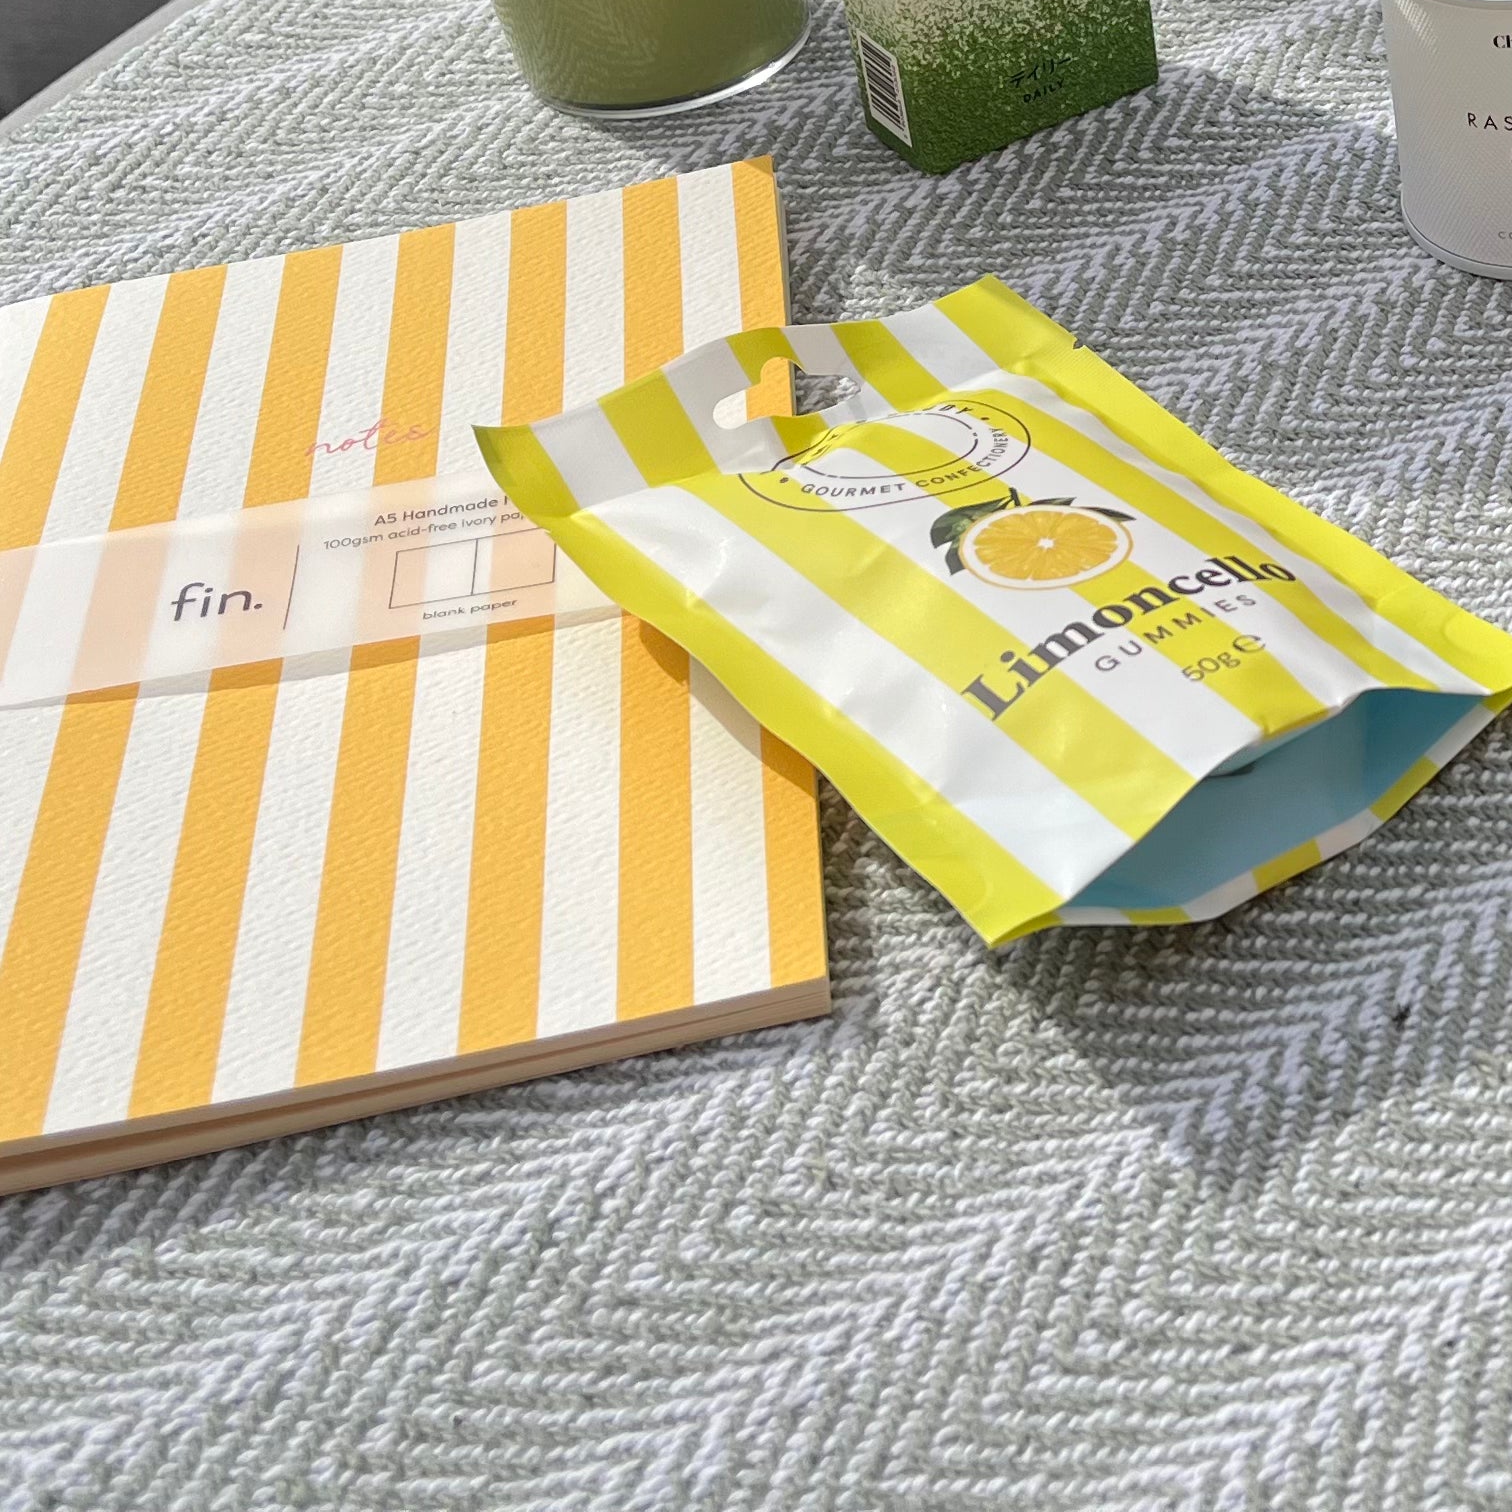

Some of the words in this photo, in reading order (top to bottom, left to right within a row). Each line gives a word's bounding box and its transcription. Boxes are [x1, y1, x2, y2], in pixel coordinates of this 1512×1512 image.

[1023, 77, 1065, 103] DAILY
[304, 416, 438, 457] notes
[801, 483, 906, 497] GOURMET
[915, 427, 1009, 487] CONFECTIONERY
[374, 513, 398, 527] A5
[402, 497, 499, 522] Handmade
[323, 533, 384, 551] 100gsm
[387, 522, 458, 540] acid-free
[462, 514, 497, 528] ivory
[170, 582, 263, 621] fin.
[422, 606, 465, 620] blank
[470, 599, 518, 615] paper
[961, 555, 1297, 721] Limoncello
[1095, 594, 1257, 672] GUMMIES
